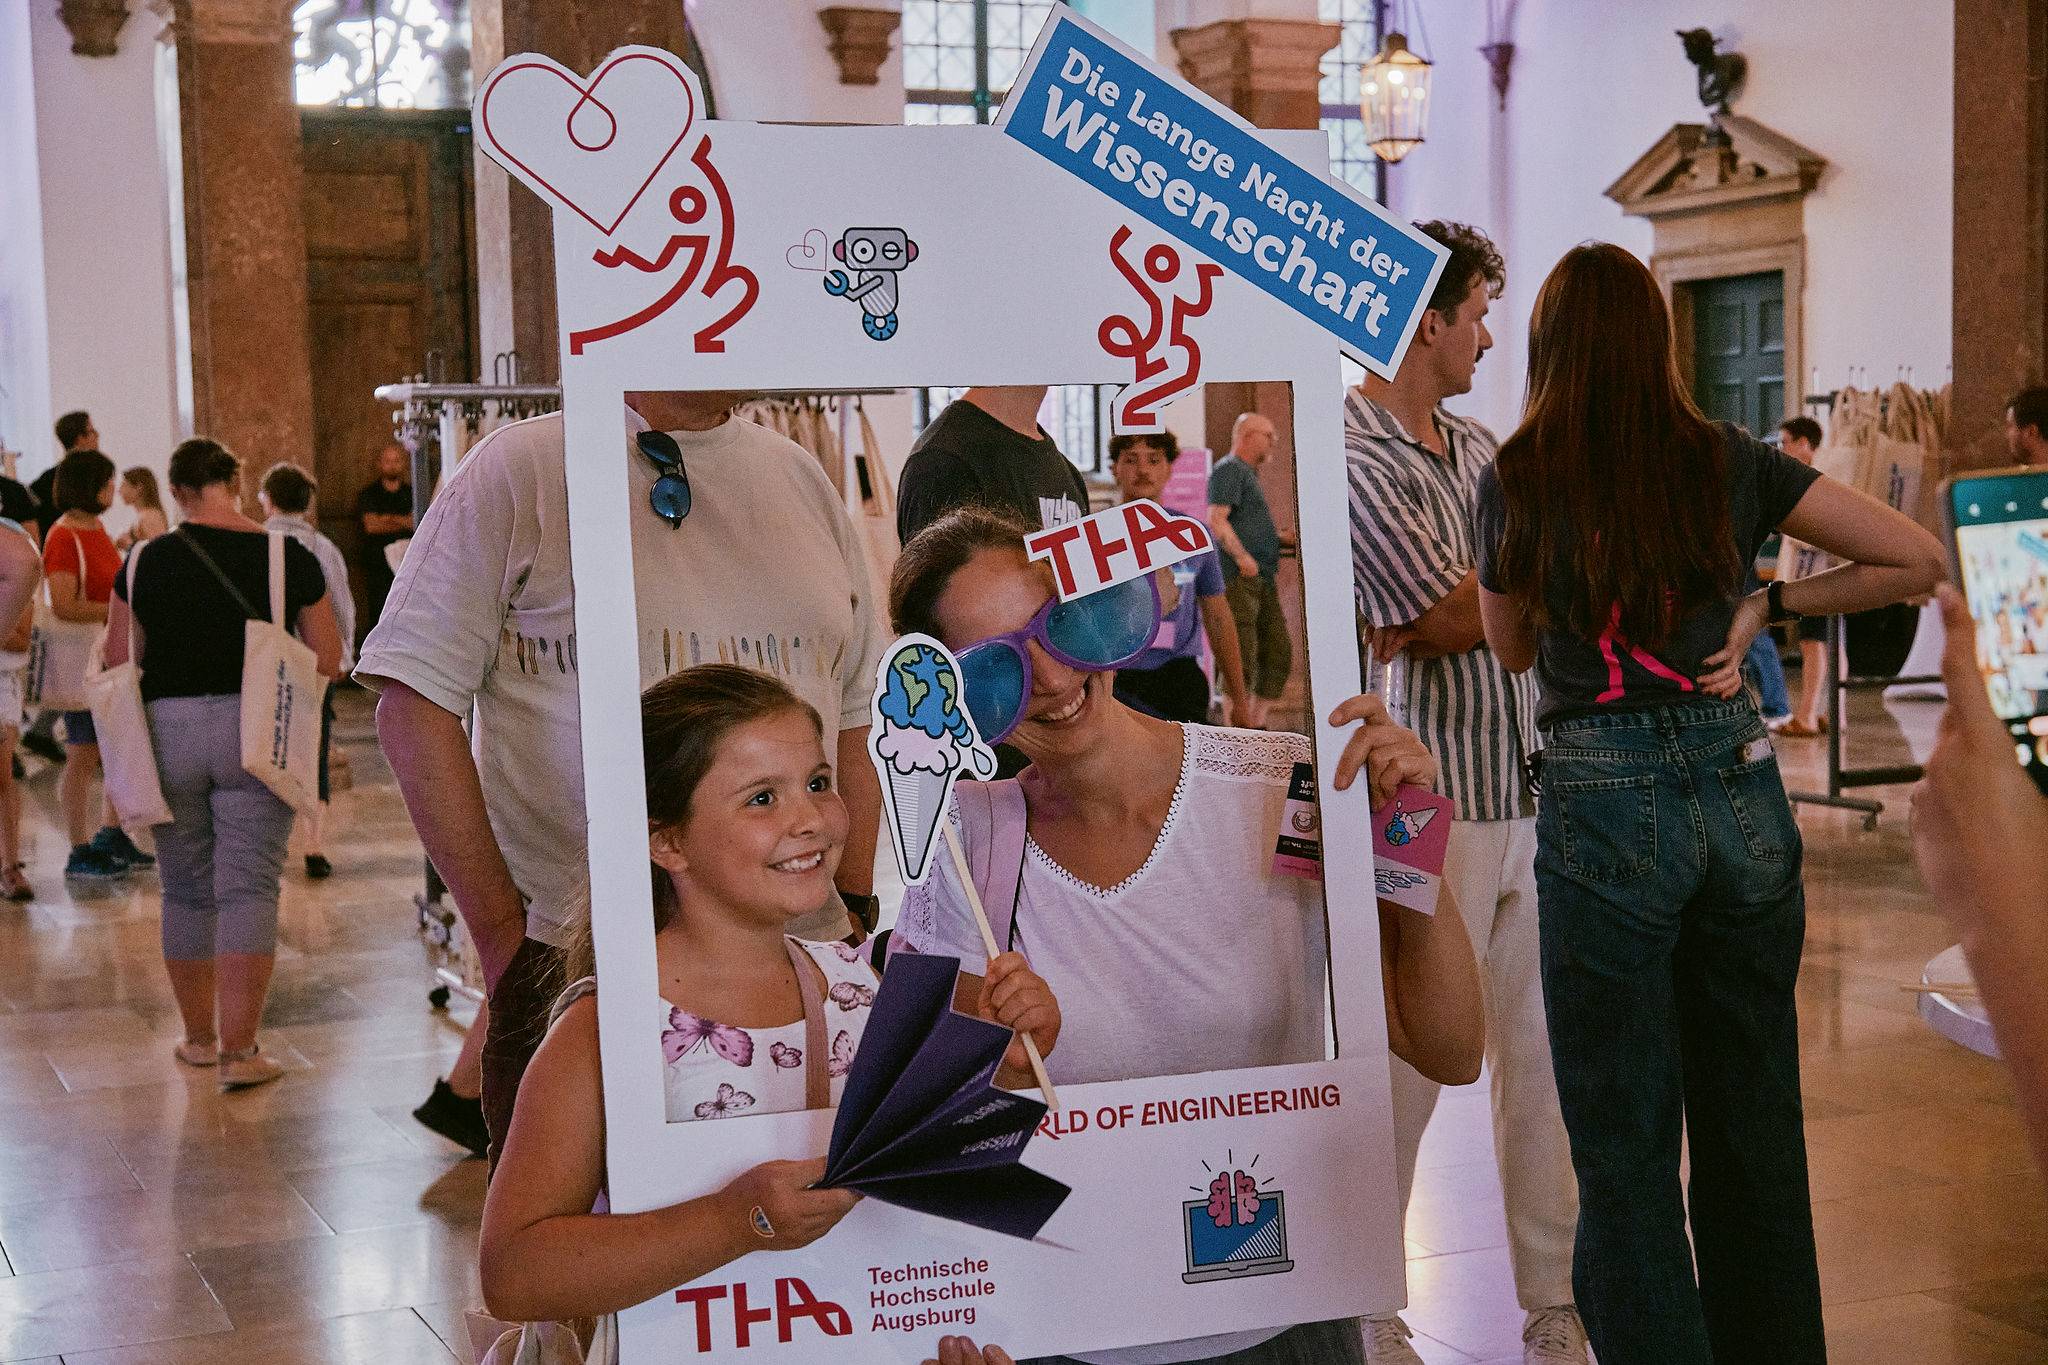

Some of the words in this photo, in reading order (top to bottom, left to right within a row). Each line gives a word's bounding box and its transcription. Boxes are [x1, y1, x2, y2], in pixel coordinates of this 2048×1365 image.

[1061, 47, 1120, 107] Die
[1126, 89, 1235, 178] Lange
[1240, 163, 1346, 248] Nacht
[1349, 235, 1410, 285] der
[1041, 85, 1390, 338] Wissenschaft
[1030, 503, 1208, 596] THA
[1034, 1109, 1089, 1140] RLD
[1096, 1104, 1134, 1130] OF
[1141, 1084, 1341, 1126] ENGINEERING
[868, 1257, 989, 1285] Technische
[870, 1278, 996, 1308] Hochschule
[675, 1277, 853, 1353] THA
[871, 1305, 977, 1332] Augsburg
